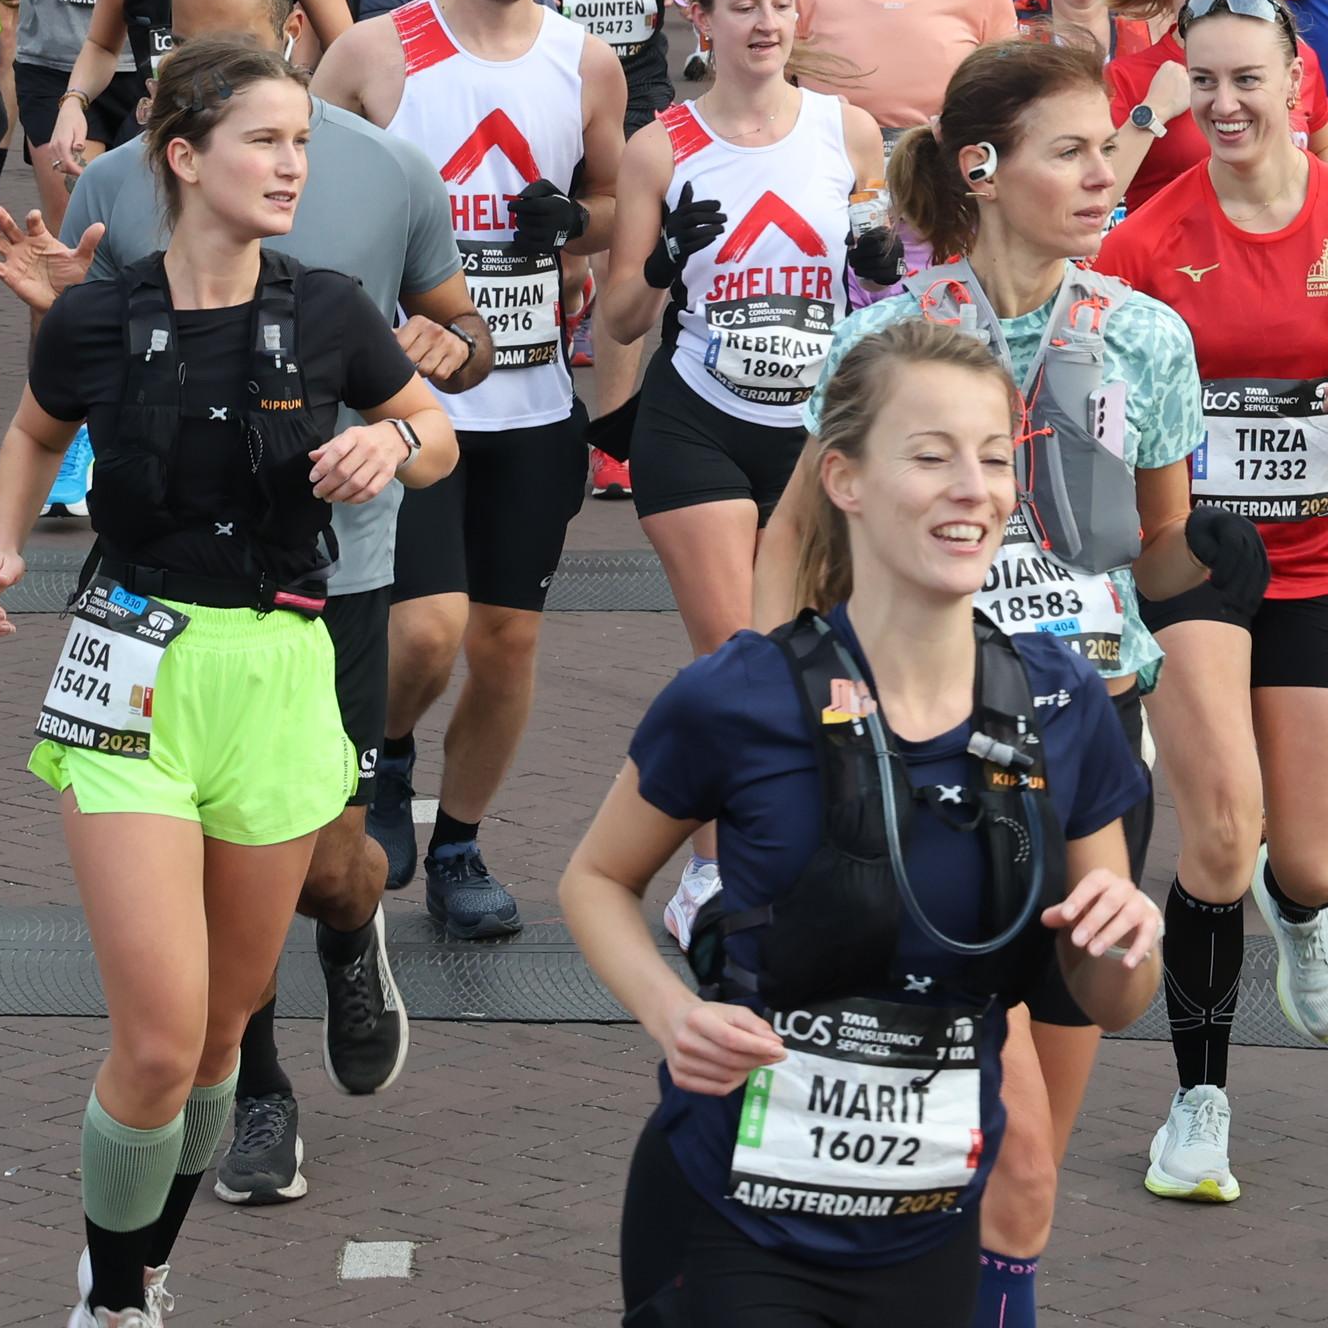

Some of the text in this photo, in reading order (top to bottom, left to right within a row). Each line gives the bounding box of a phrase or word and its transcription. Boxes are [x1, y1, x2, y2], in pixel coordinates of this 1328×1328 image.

[575, 0, 645, 19] QUINTEN
[587, 20, 633, 36] 15473
[154, 32, 172, 51] tc
[481, 248, 503, 256] TATA
[481, 255, 528, 264] CONSULTANCY
[481, 263, 513, 272] SERVICES
[535, 257, 553, 269] TATA
[705, 265, 833, 304] SHELTER
[1306, 282, 1318, 290] tcs
[488, 312, 533, 332] 8916
[712, 301, 770, 327] tcs TATA
[748, 308, 798, 318] CONSULTANCY
[748, 314, 782, 324] SERVICES
[804, 318, 829, 331] TATA
[726, 331, 823, 359] REBEKAH
[261, 399, 303, 410] KIPRUN
[1202, 387, 1269, 411] tcs TATA
[1244, 395, 1299, 405] CONSULTANCY
[1244, 403, 1279, 412] SERVICES
[1235, 428, 1307, 452] TIRZA
[1235, 459, 1306, 481] 17332
[94, 586, 108, 598] TATA
[85, 603, 108, 619] SERVICES
[90, 595, 130, 619] CONSULTANCY
[123, 594, 141, 610] 830
[989, 588, 1084, 625] 18583
[135, 624, 166, 641] TATA
[1053, 621, 1076, 633] 404
[68, 632, 111, 673] LISA
[56, 664, 111, 708] 15474
[34, 712, 148, 754] TERDAM 2025
[842, 1011, 880, 1029] TATA
[838, 1025, 923, 1048] CONSULTANCY
[836, 1037, 891, 1058] SERVICES
[808, 1075, 931, 1124] MARIT
[809, 1126, 922, 1167] 16072
[732, 1180, 958, 1218] AMSTERDAM 2025
